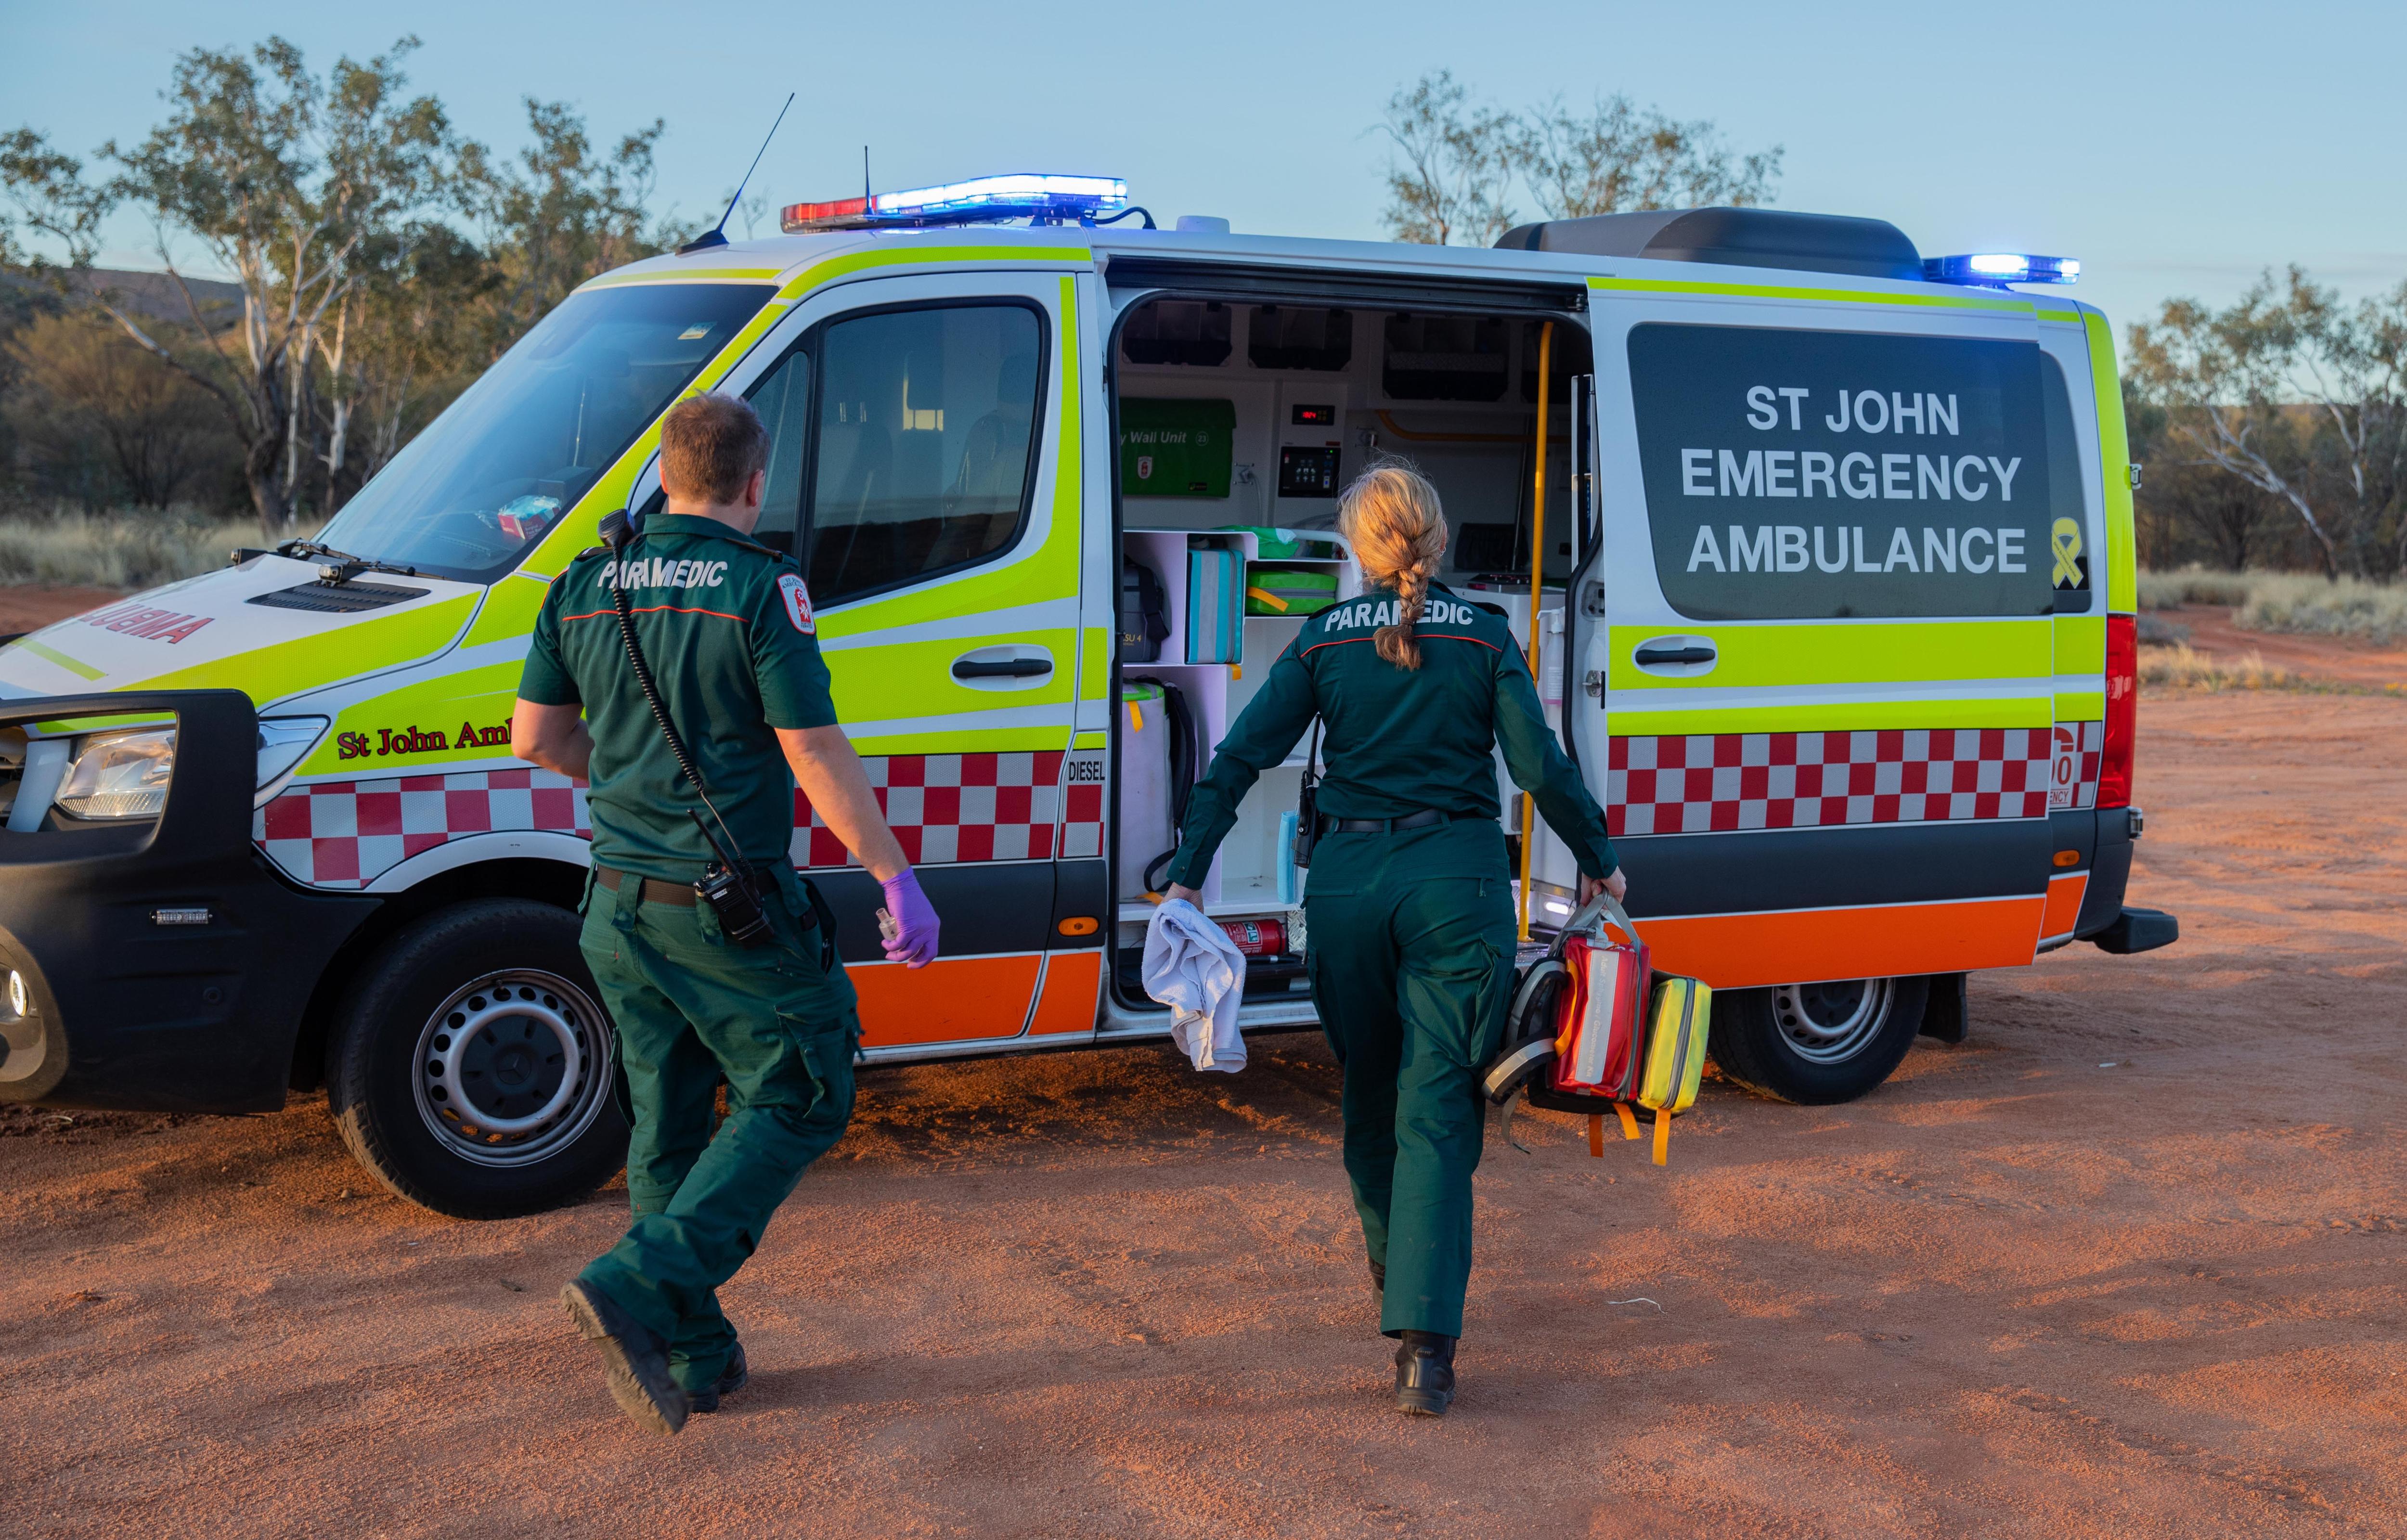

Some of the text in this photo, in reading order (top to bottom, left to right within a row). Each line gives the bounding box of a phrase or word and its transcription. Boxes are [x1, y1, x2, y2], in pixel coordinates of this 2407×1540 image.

[1747, 386, 1958, 436] ST JOHN
[1130, 431, 1156, 443] Wall
[1161, 431, 1187, 443] Unit
[1681, 448, 2021, 502] EMERGENCY
[1686, 525, 2026, 574] AMBULANCE
[597, 556, 728, 590] PARAMEDIC
[1123, 634, 1141, 642] SU 4
[337, 731, 371, 760] St
[377, 725, 449, 756] John
[1069, 761, 1105, 781] DIESEL
